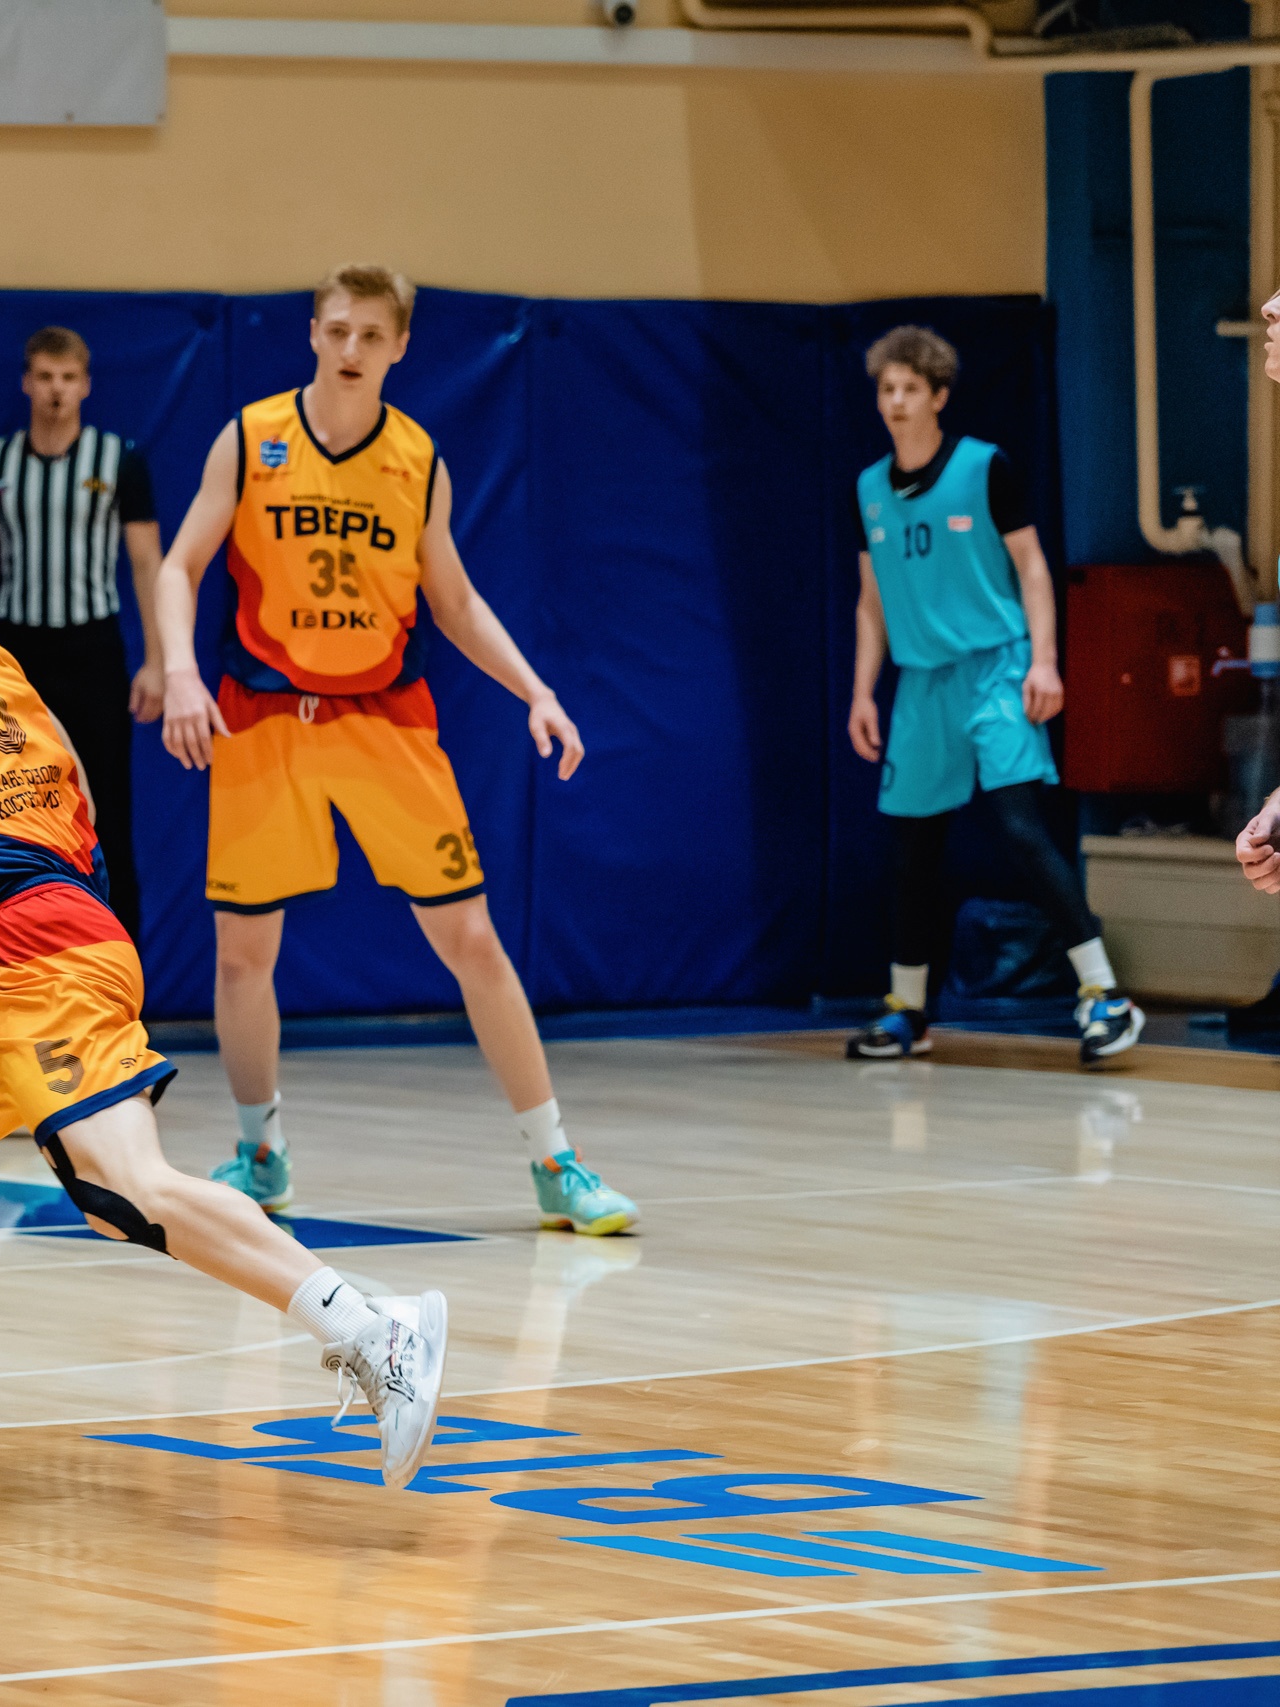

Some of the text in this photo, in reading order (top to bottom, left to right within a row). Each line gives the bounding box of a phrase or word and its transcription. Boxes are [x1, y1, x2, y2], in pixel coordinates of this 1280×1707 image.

[265, 505, 396, 551] ТВЕРЬ
[904, 522, 932, 560] 10
[308, 549, 360, 598] 35
[33, 1036, 85, 1095] 5
